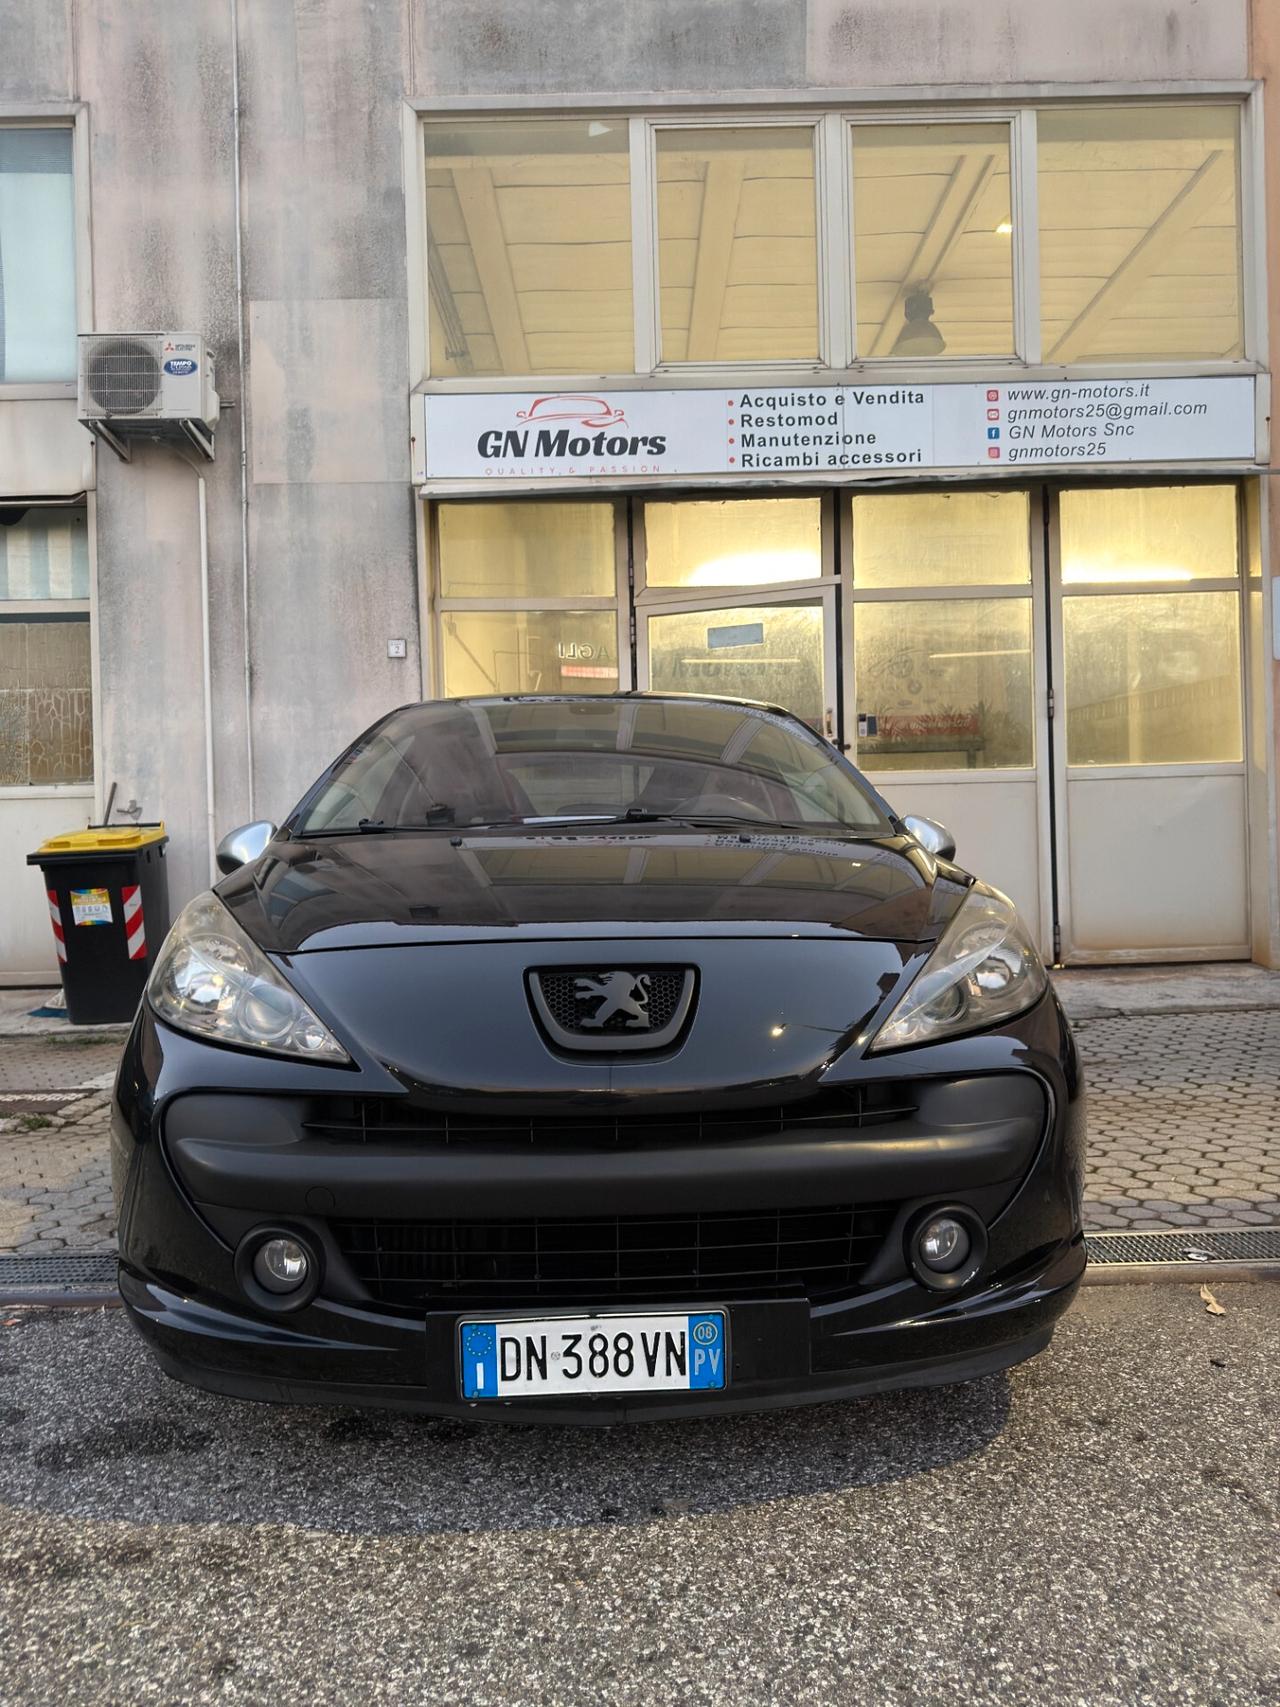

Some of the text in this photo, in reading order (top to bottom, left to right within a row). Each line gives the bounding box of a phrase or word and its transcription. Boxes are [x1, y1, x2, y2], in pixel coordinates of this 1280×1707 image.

[740, 390, 925, 410] Acquisto e Vendita
[1007, 384, 1150, 402] www.gn-motors.it
[740, 412, 838, 428] Restomod
[1007, 402, 1208, 423] gnmotors25@gmail.com
[741, 431, 877, 448] Manutenzione
[1008, 422, 1135, 439] GN Motors Snc
[477, 429, 667, 458] GN Motors
[1008, 442, 1107, 462] gnmotors25
[741, 449, 922, 467] Ricambi accessori
[485, 467, 556, 476] QUALITY
[589, 465, 660, 473] PASSION
[696, 1326, 715, 1340] 08
[500, 1335, 548, 1382] DN
[561, 1331, 686, 1380] 388VN
[694, 1348, 721, 1376] PV
